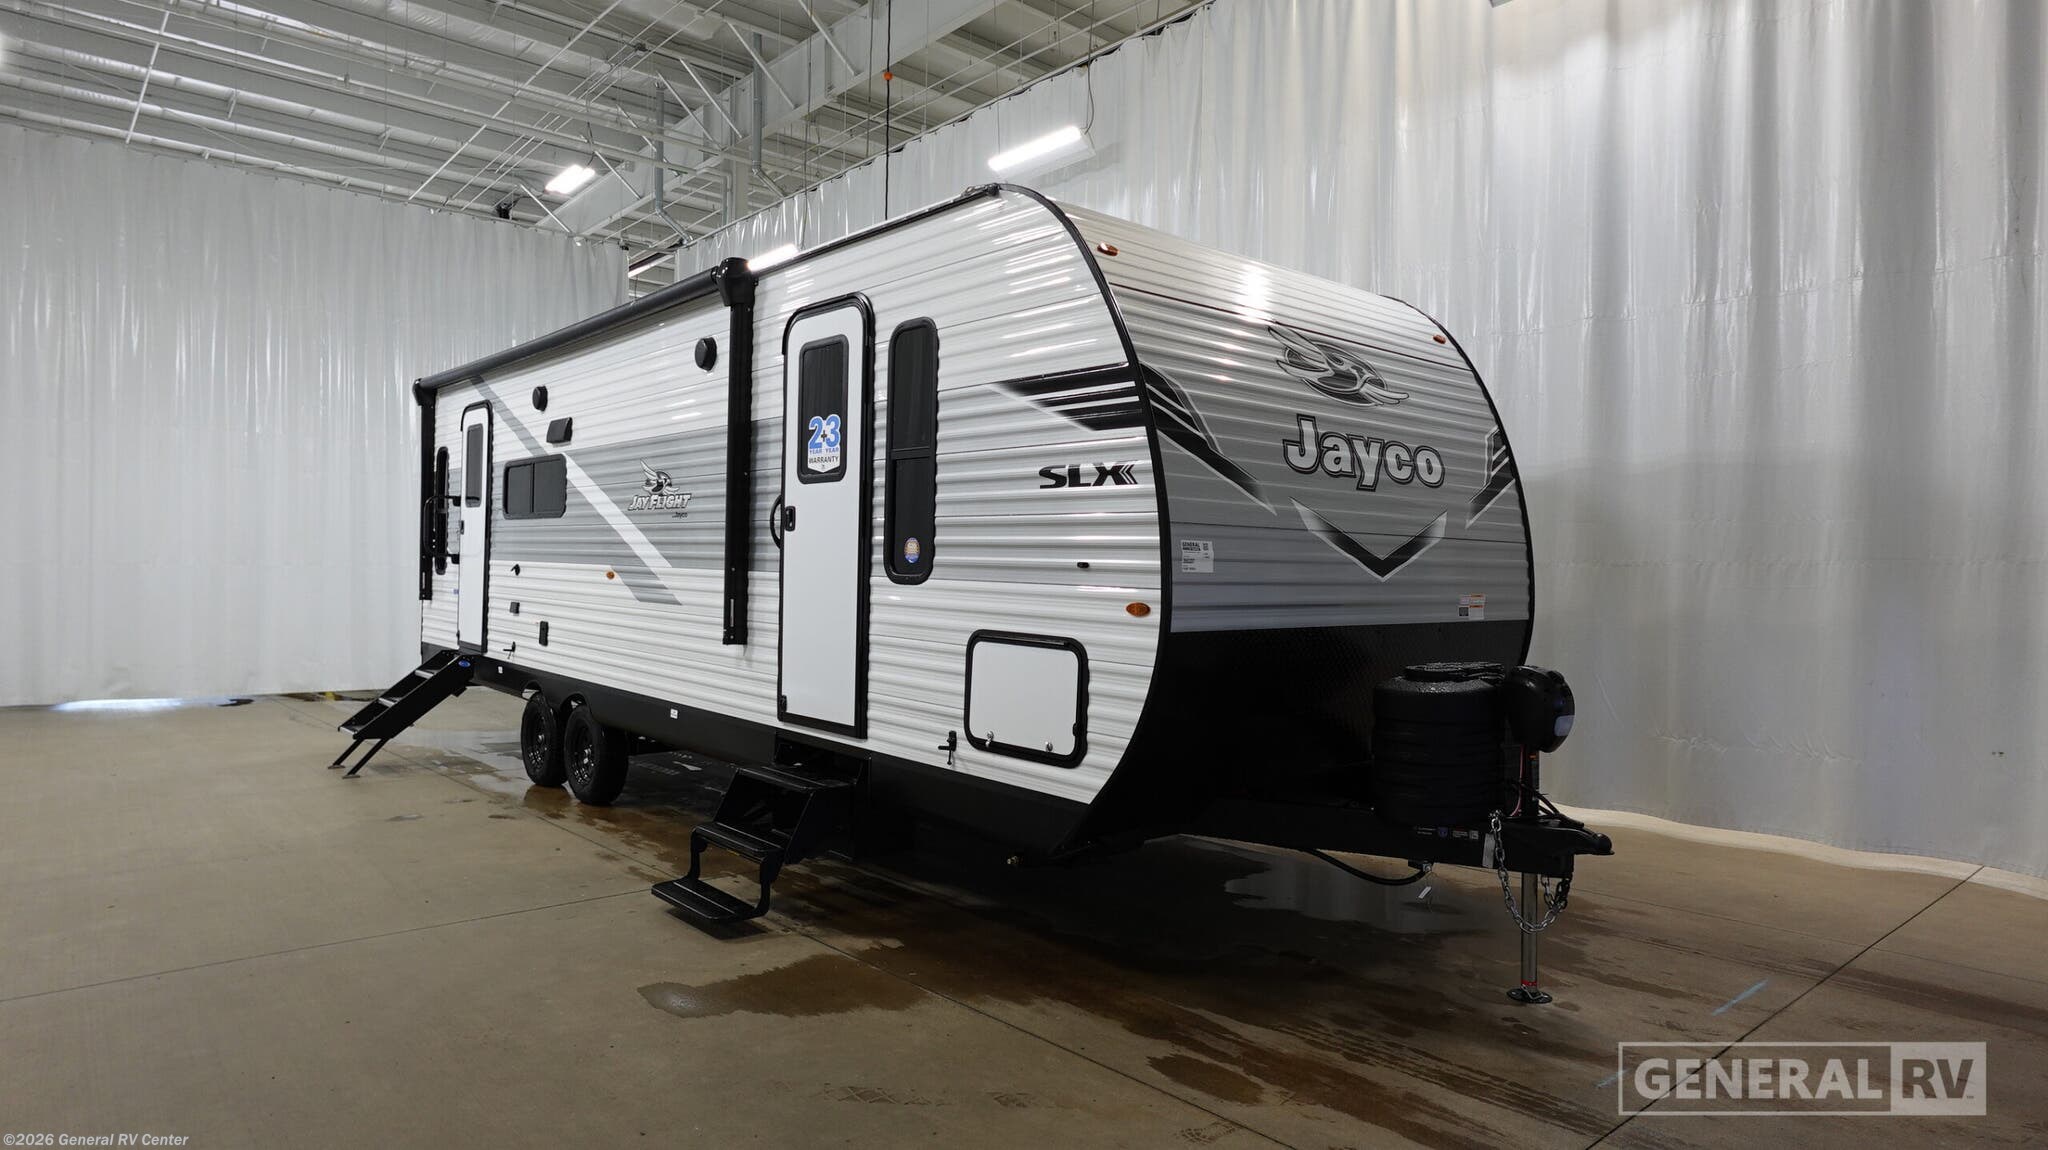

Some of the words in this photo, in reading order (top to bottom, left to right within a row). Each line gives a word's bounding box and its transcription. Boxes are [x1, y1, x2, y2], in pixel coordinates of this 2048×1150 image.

[808, 456, 839, 464] WARRANTY
[1283, 413, 1446, 493] Jayco
[627, 495, 650, 511] JAY
[647, 493, 692, 510] FLIGHT
